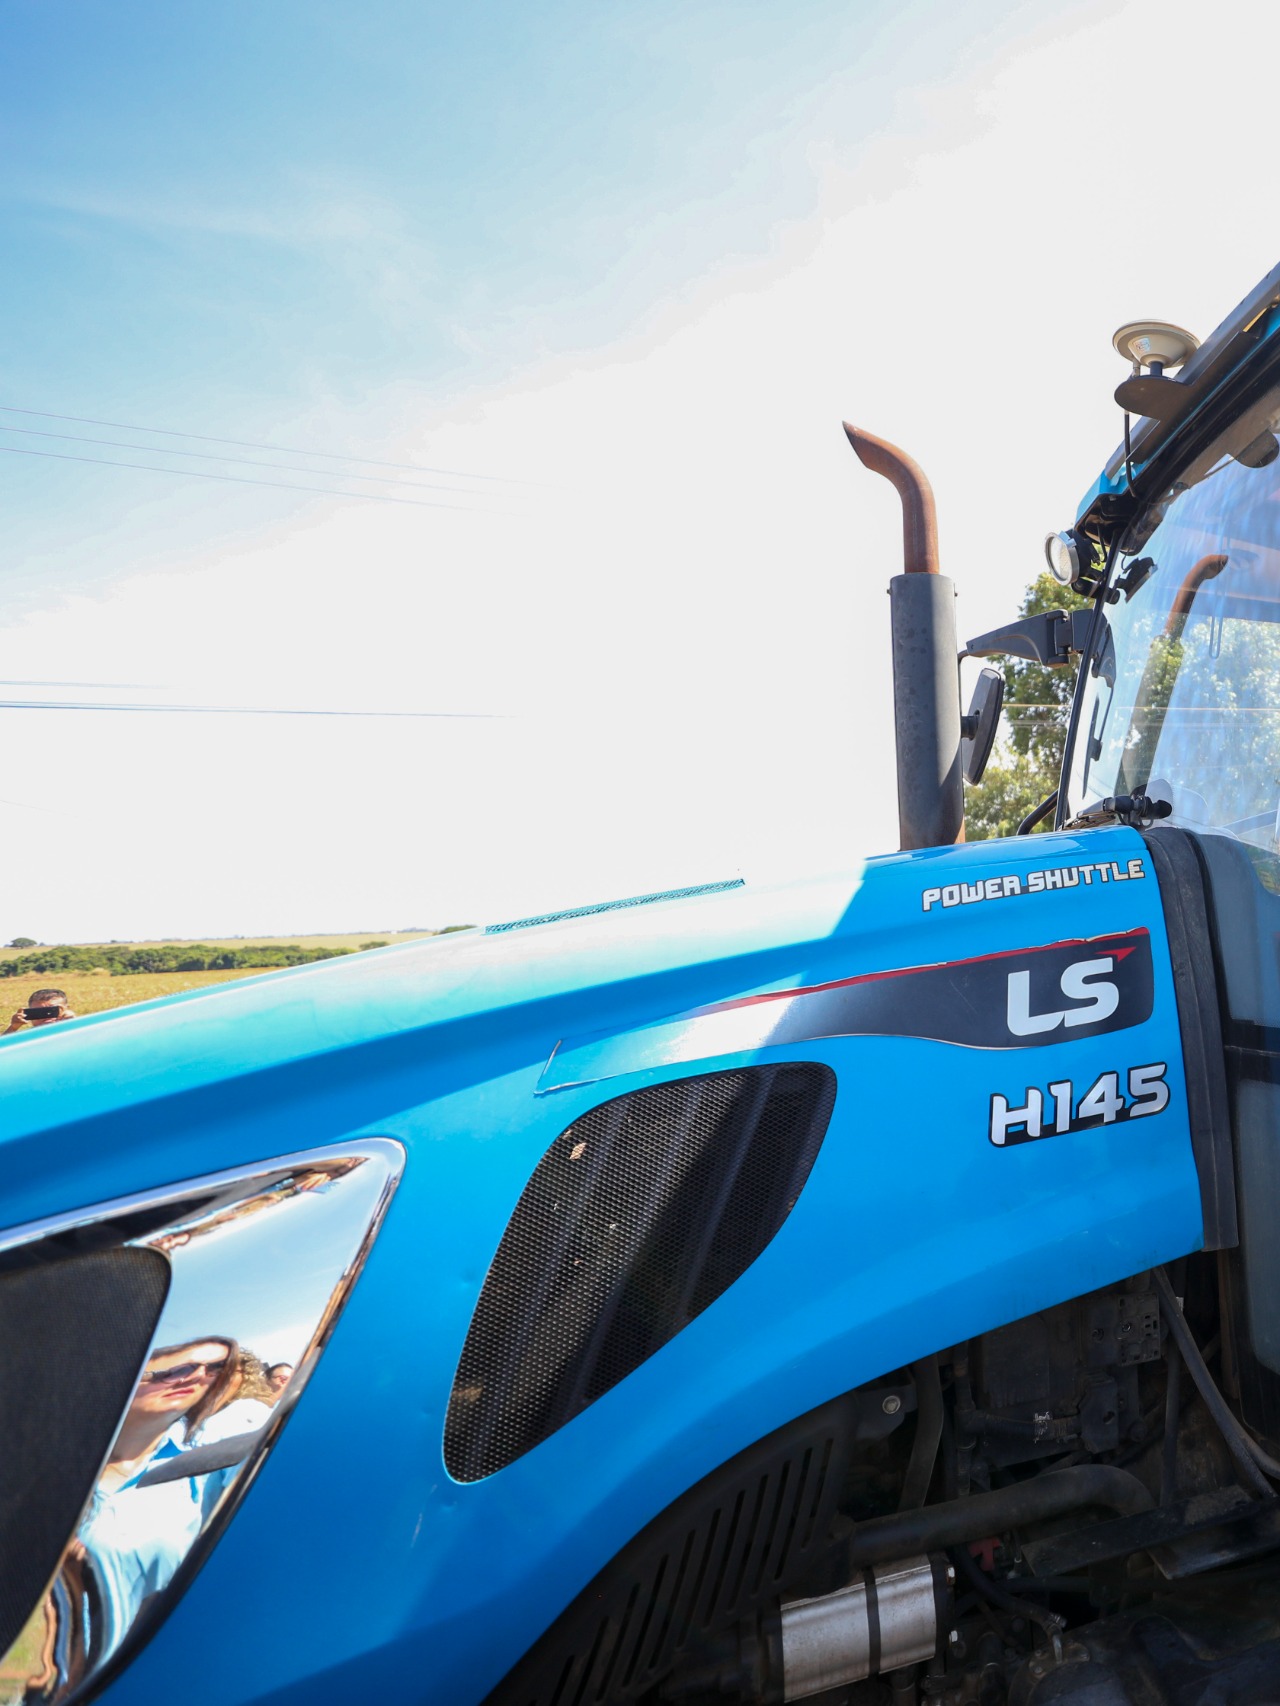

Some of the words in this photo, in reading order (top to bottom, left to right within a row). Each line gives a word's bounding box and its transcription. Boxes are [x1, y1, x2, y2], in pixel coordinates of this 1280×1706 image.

[922, 875, 1020, 911] POWER
[1028, 859, 1145, 893] SHUTTLE
[1007, 957, 1119, 1037] LS
[989, 1063, 1169, 1147] H145
